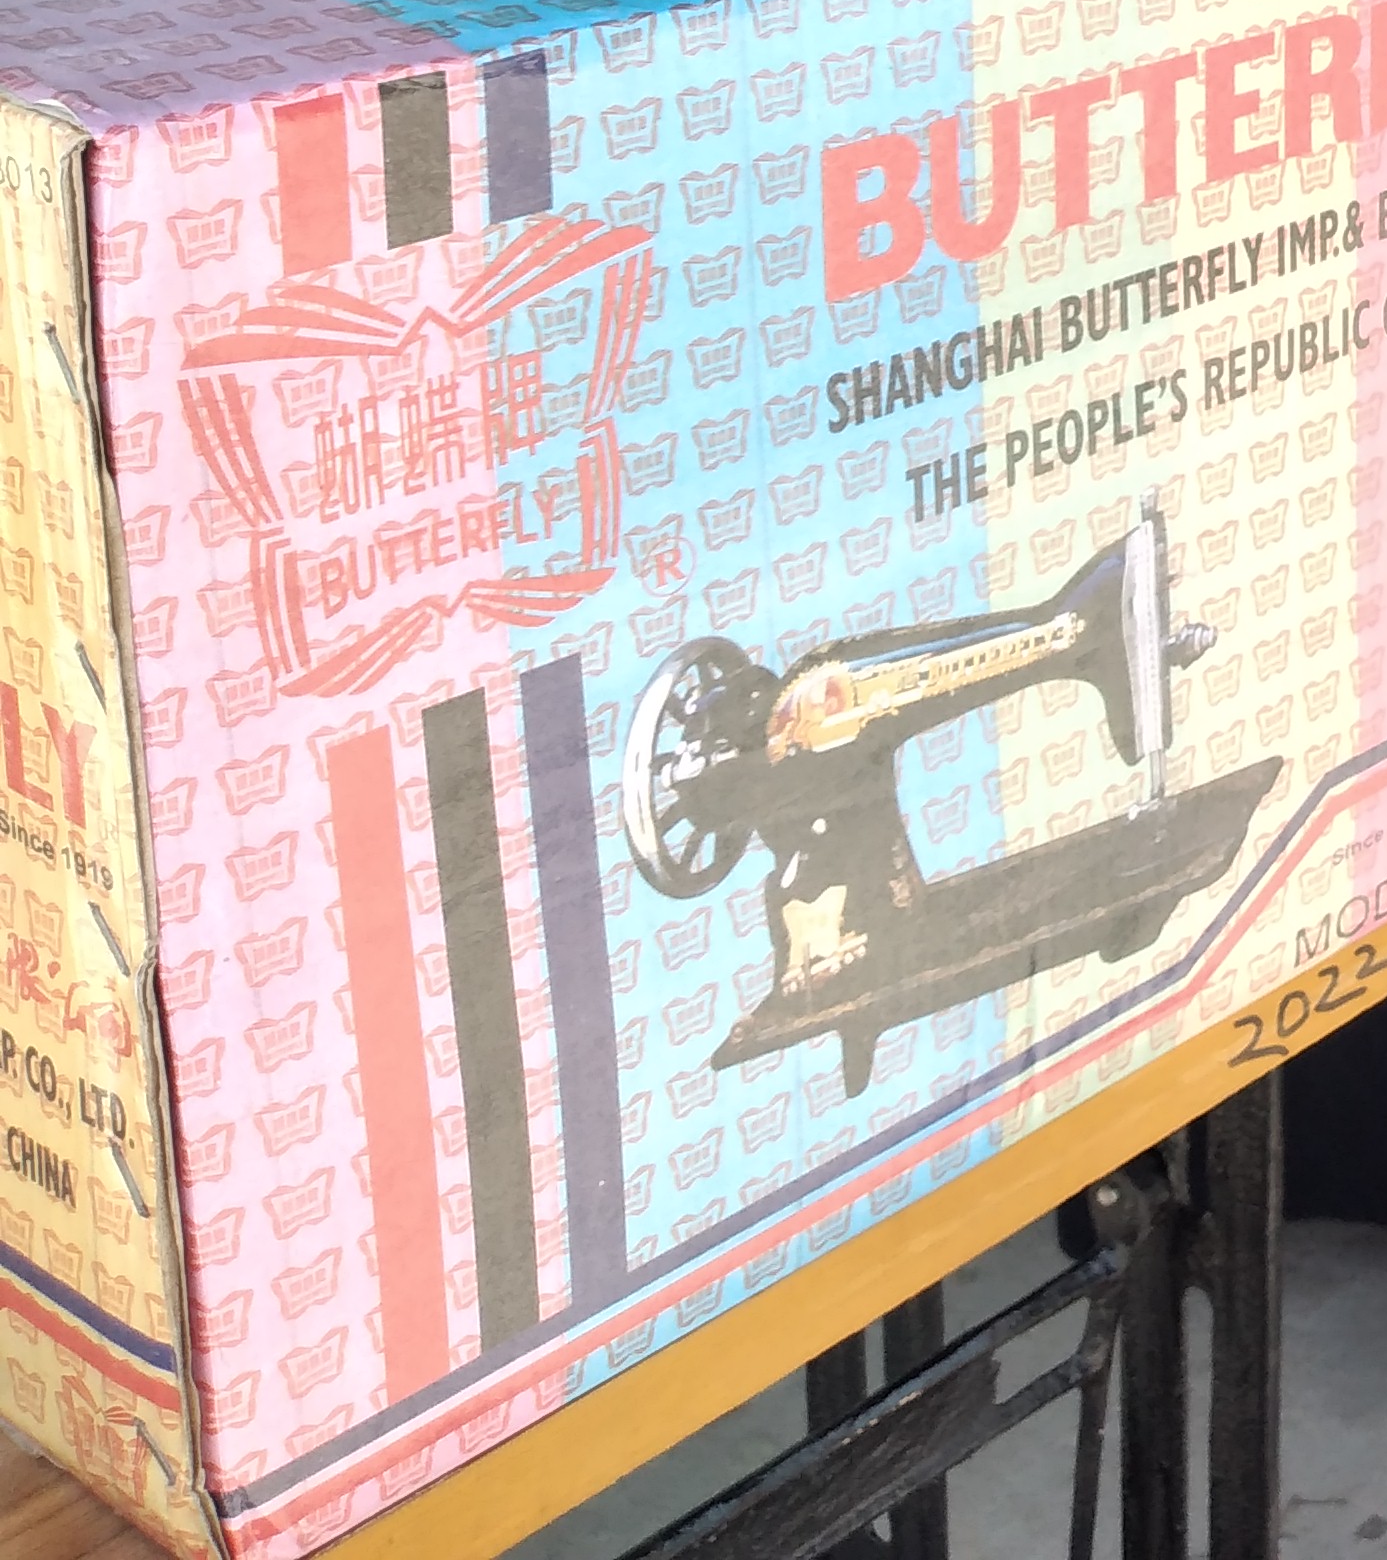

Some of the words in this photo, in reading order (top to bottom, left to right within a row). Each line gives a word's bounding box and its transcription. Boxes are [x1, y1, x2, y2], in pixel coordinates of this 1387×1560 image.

[826, 306, 1044, 434] SHANGHAI
[1060, 232, 1263, 353] BUTTERFLY
[905, 443, 988, 523] THE
[1006, 369, 1188, 488] PEOPLE'S
[1204, 299, 1370, 413] REPUBLIC
[320, 484, 560, 619] BUTTERFLY
[0, 808, 55, 860] Since
[61, 846, 114, 891] 1919
[1332, 830, 1384, 867] Since
[26, 1045, 72, 1121] CO.,
[79, 1077, 136, 1149] LTD.
[7, 1126, 77, 1209] CHINA
